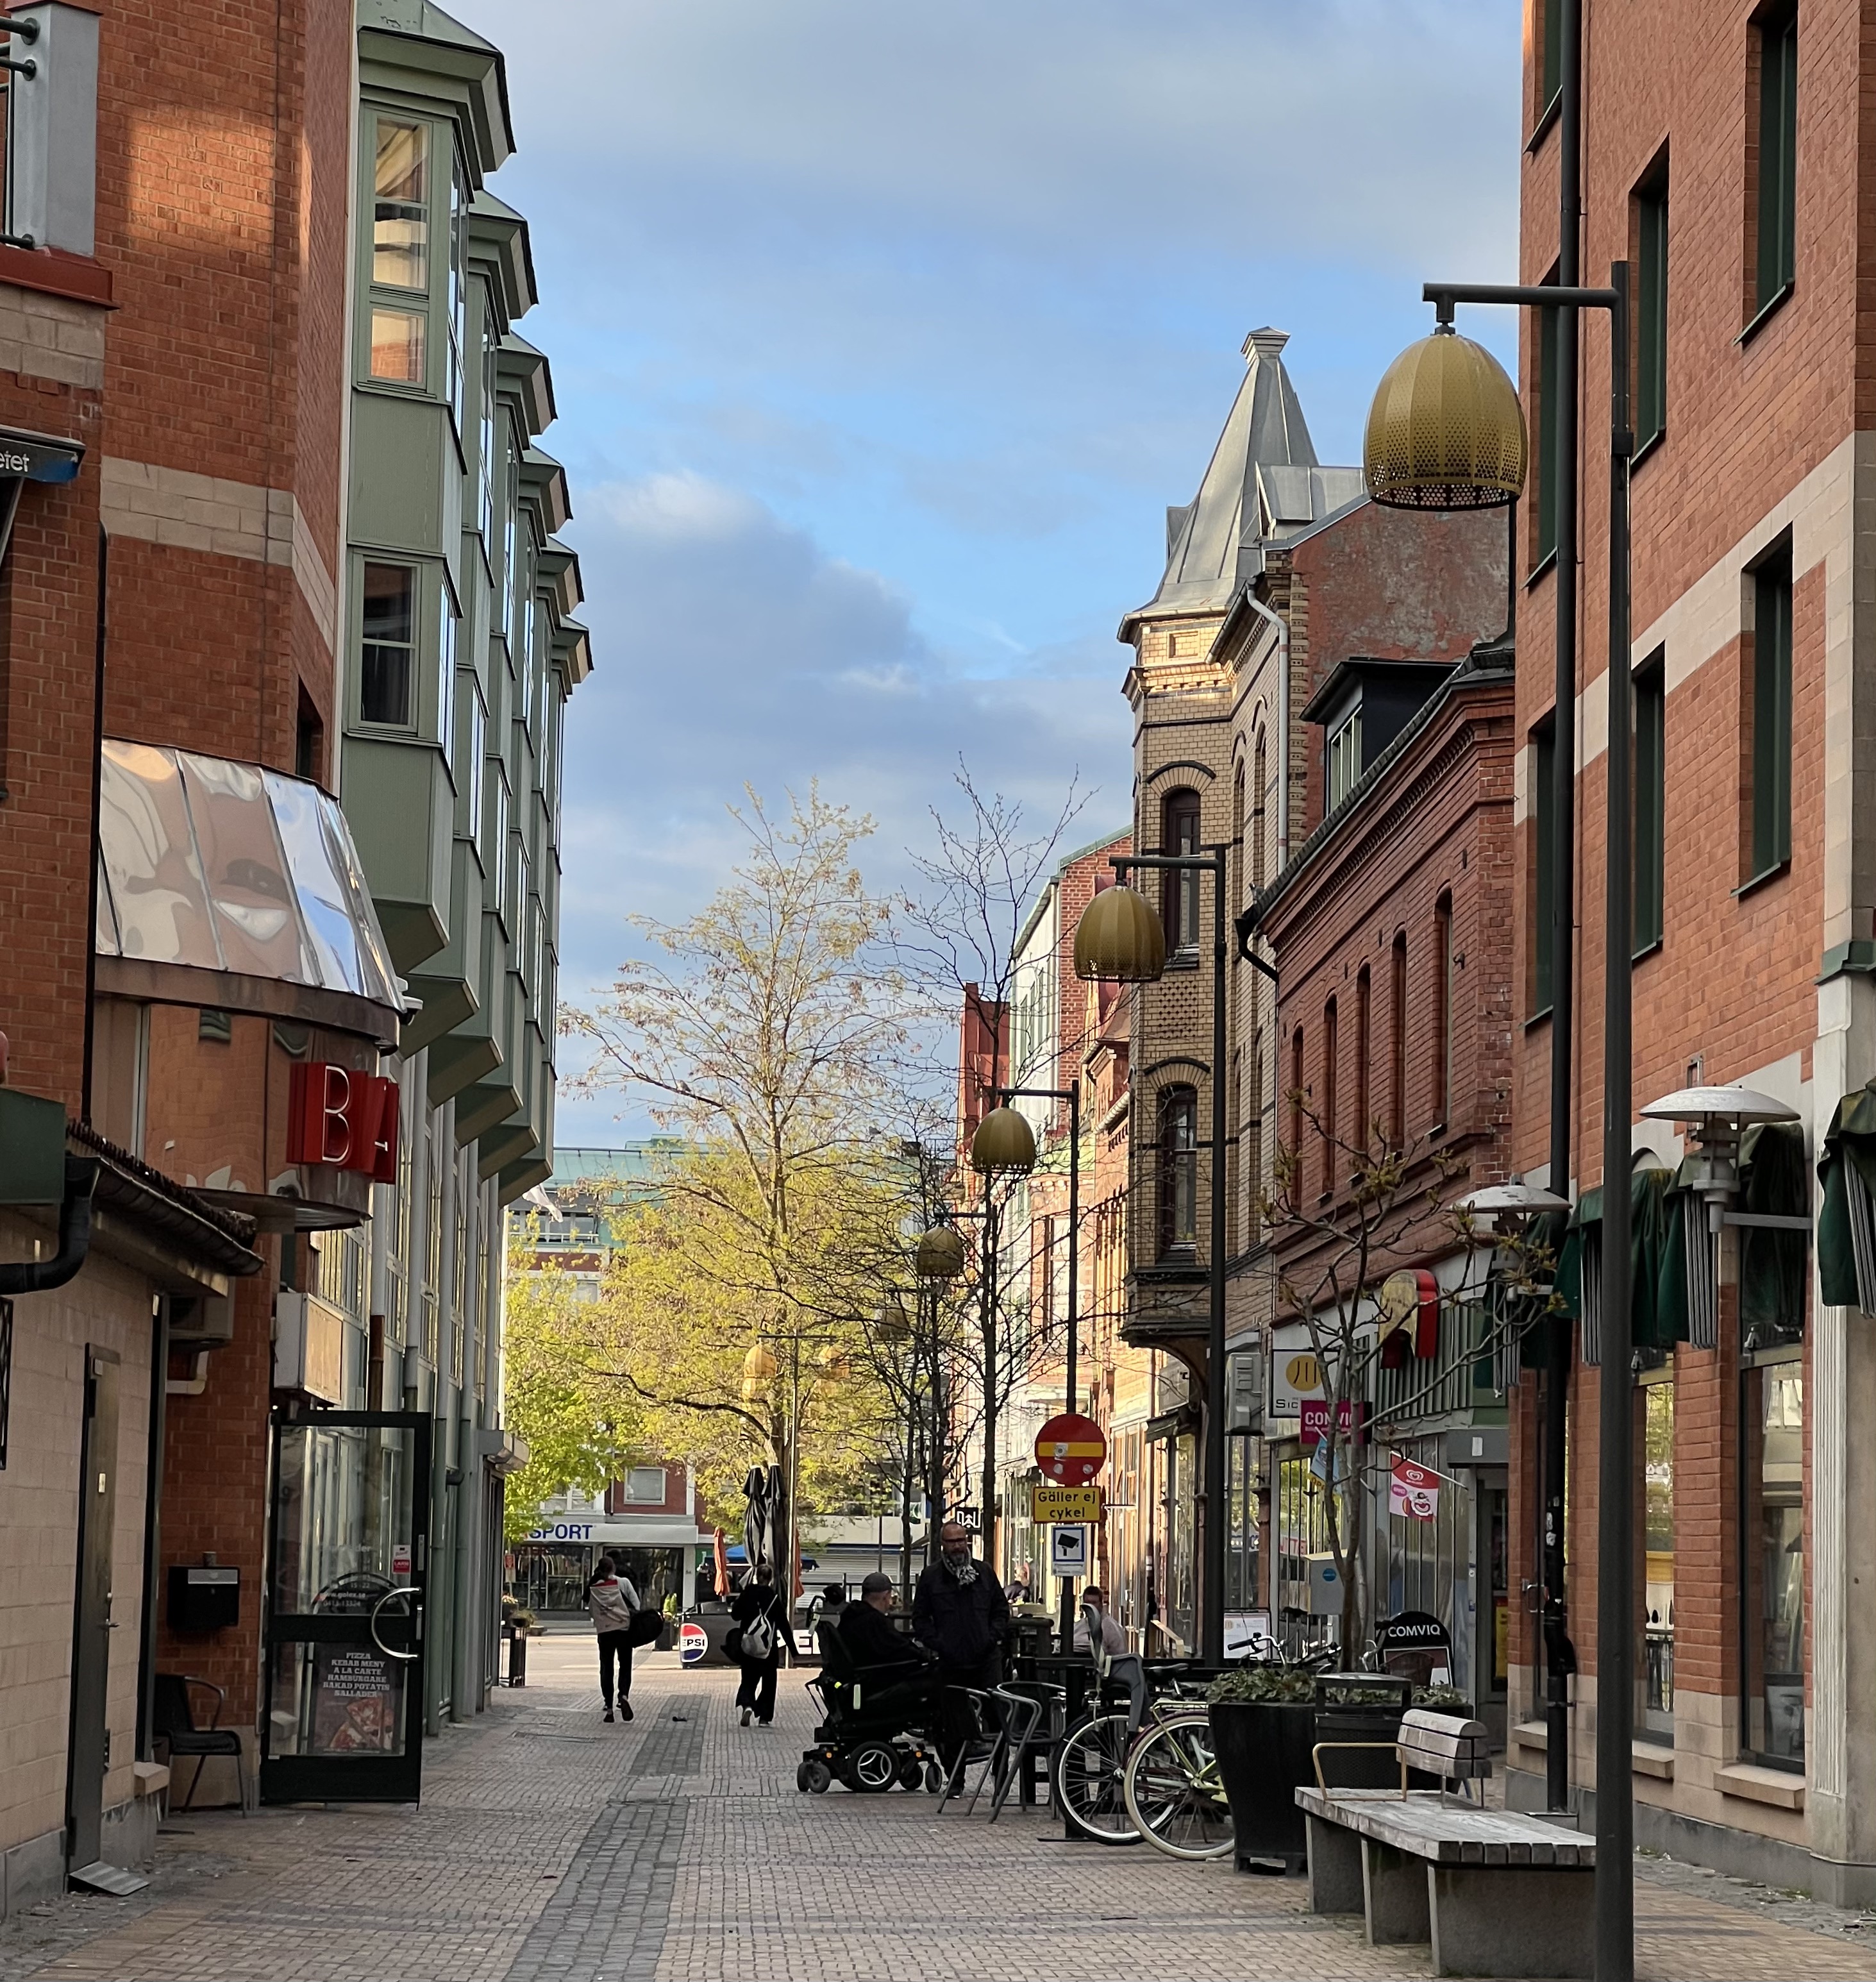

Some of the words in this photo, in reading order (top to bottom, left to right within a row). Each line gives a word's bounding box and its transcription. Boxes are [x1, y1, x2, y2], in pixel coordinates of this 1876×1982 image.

[1038, 1491, 1078, 1502] Gäller
[1083, 1491, 1096, 1504] ej
[1050, 1507, 1085, 1520] cykel
[1387, 1624, 1441, 1638] COMVIQ
[328, 1674, 387, 1683] HAMBURGARE
